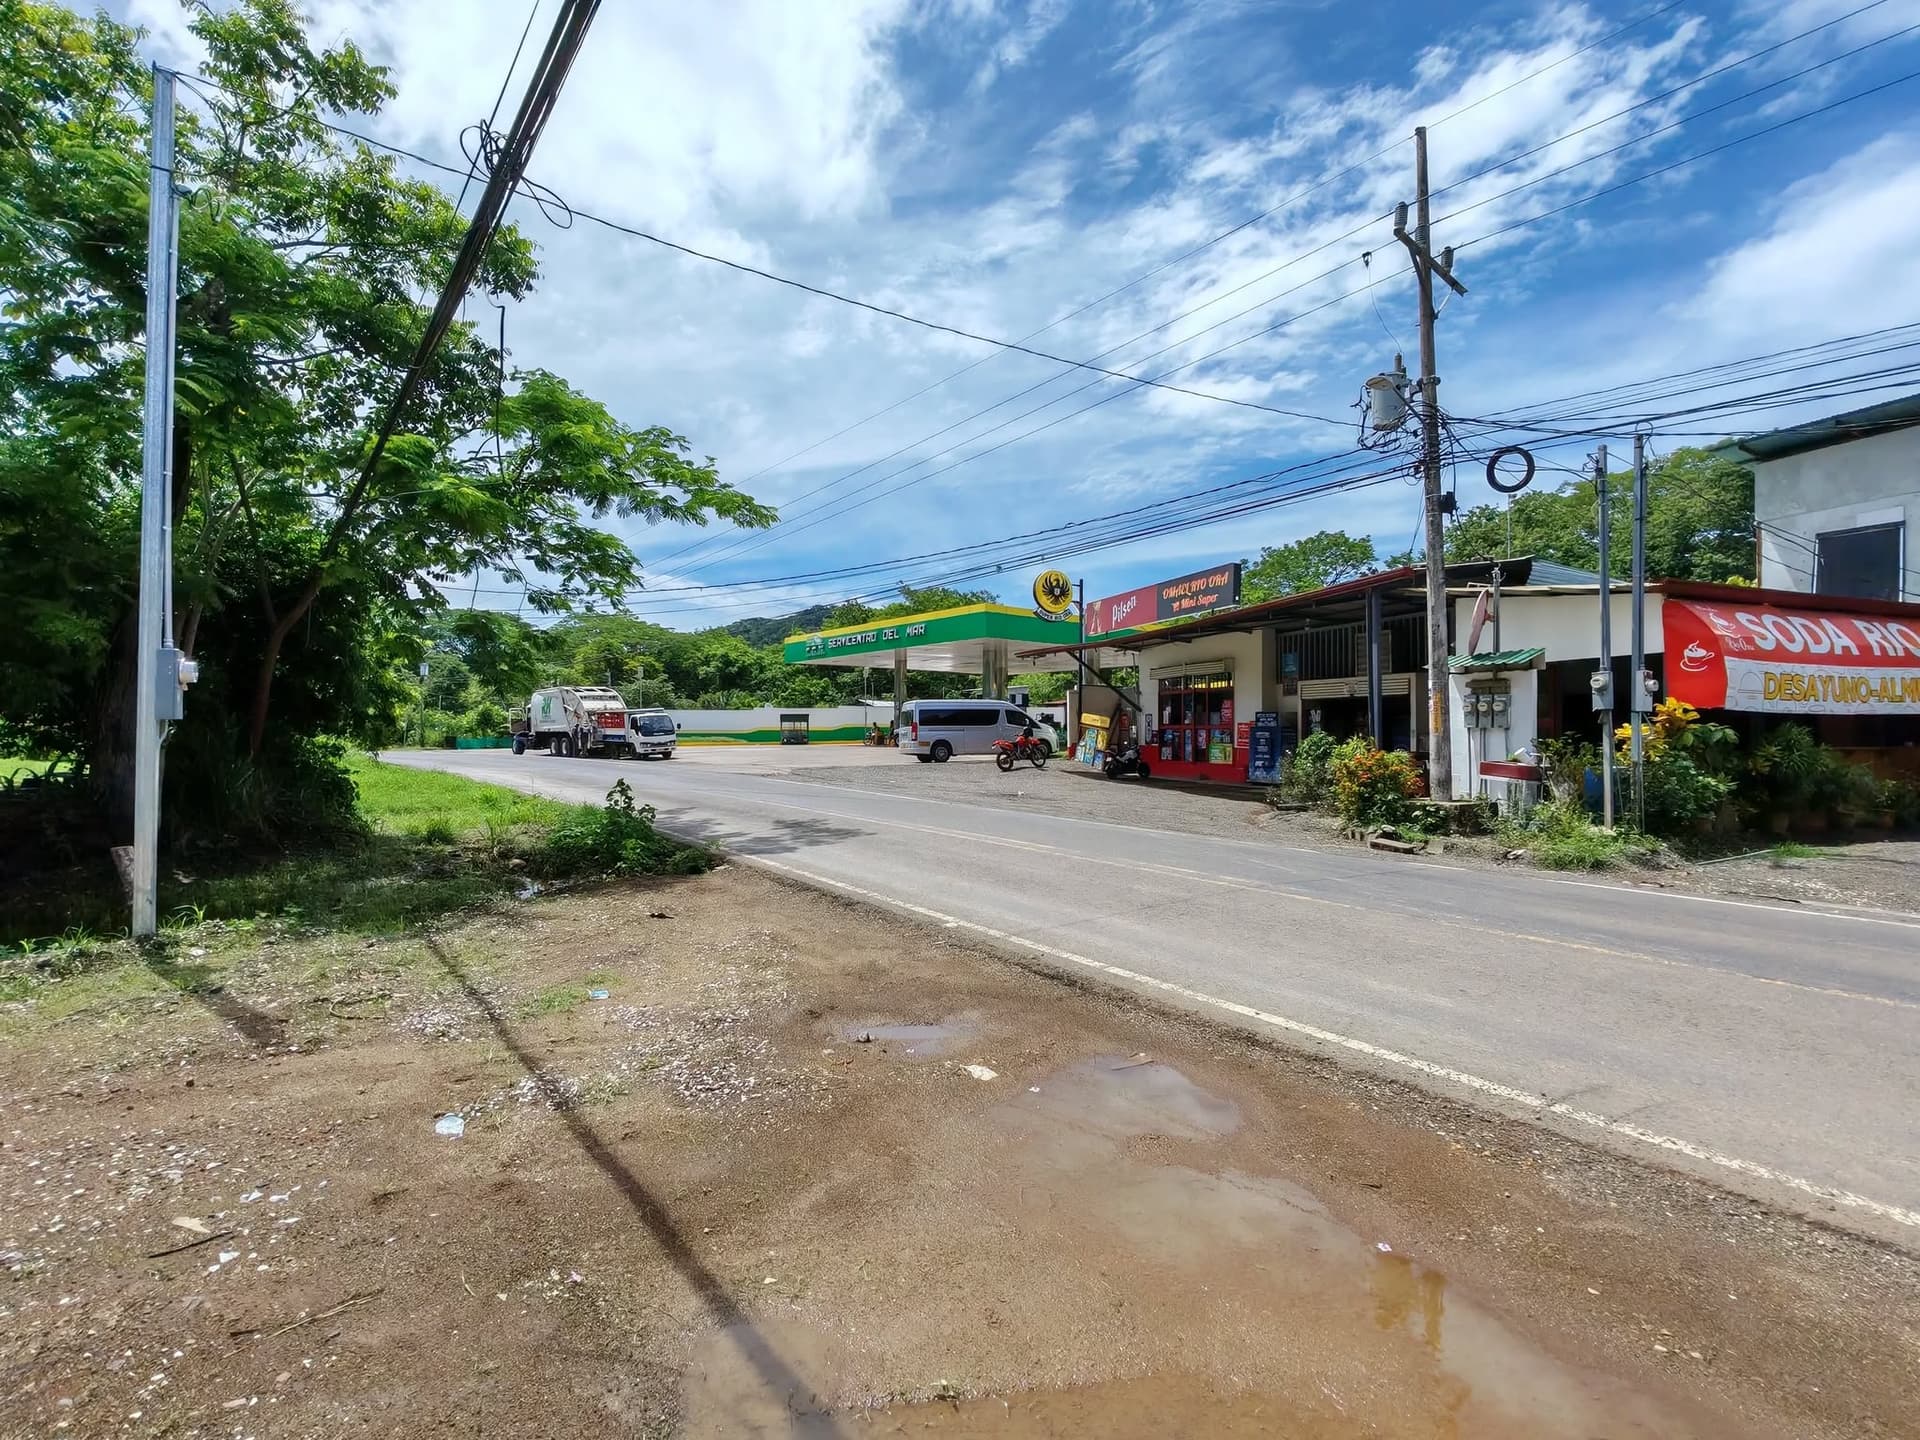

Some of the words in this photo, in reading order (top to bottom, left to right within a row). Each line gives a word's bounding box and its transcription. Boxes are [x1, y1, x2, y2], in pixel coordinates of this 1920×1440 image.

[1112, 596, 1137, 628] Pilsen
[1197, 593, 1219, 608] Super
[827, 632, 877, 649] SERVICENTRO
[882, 628, 900, 640] DEL
[905, 624, 926, 637] MAR
[1735, 612, 1860, 655] SODA
[1763, 671, 1920, 703] DESAYUNO-ALM
